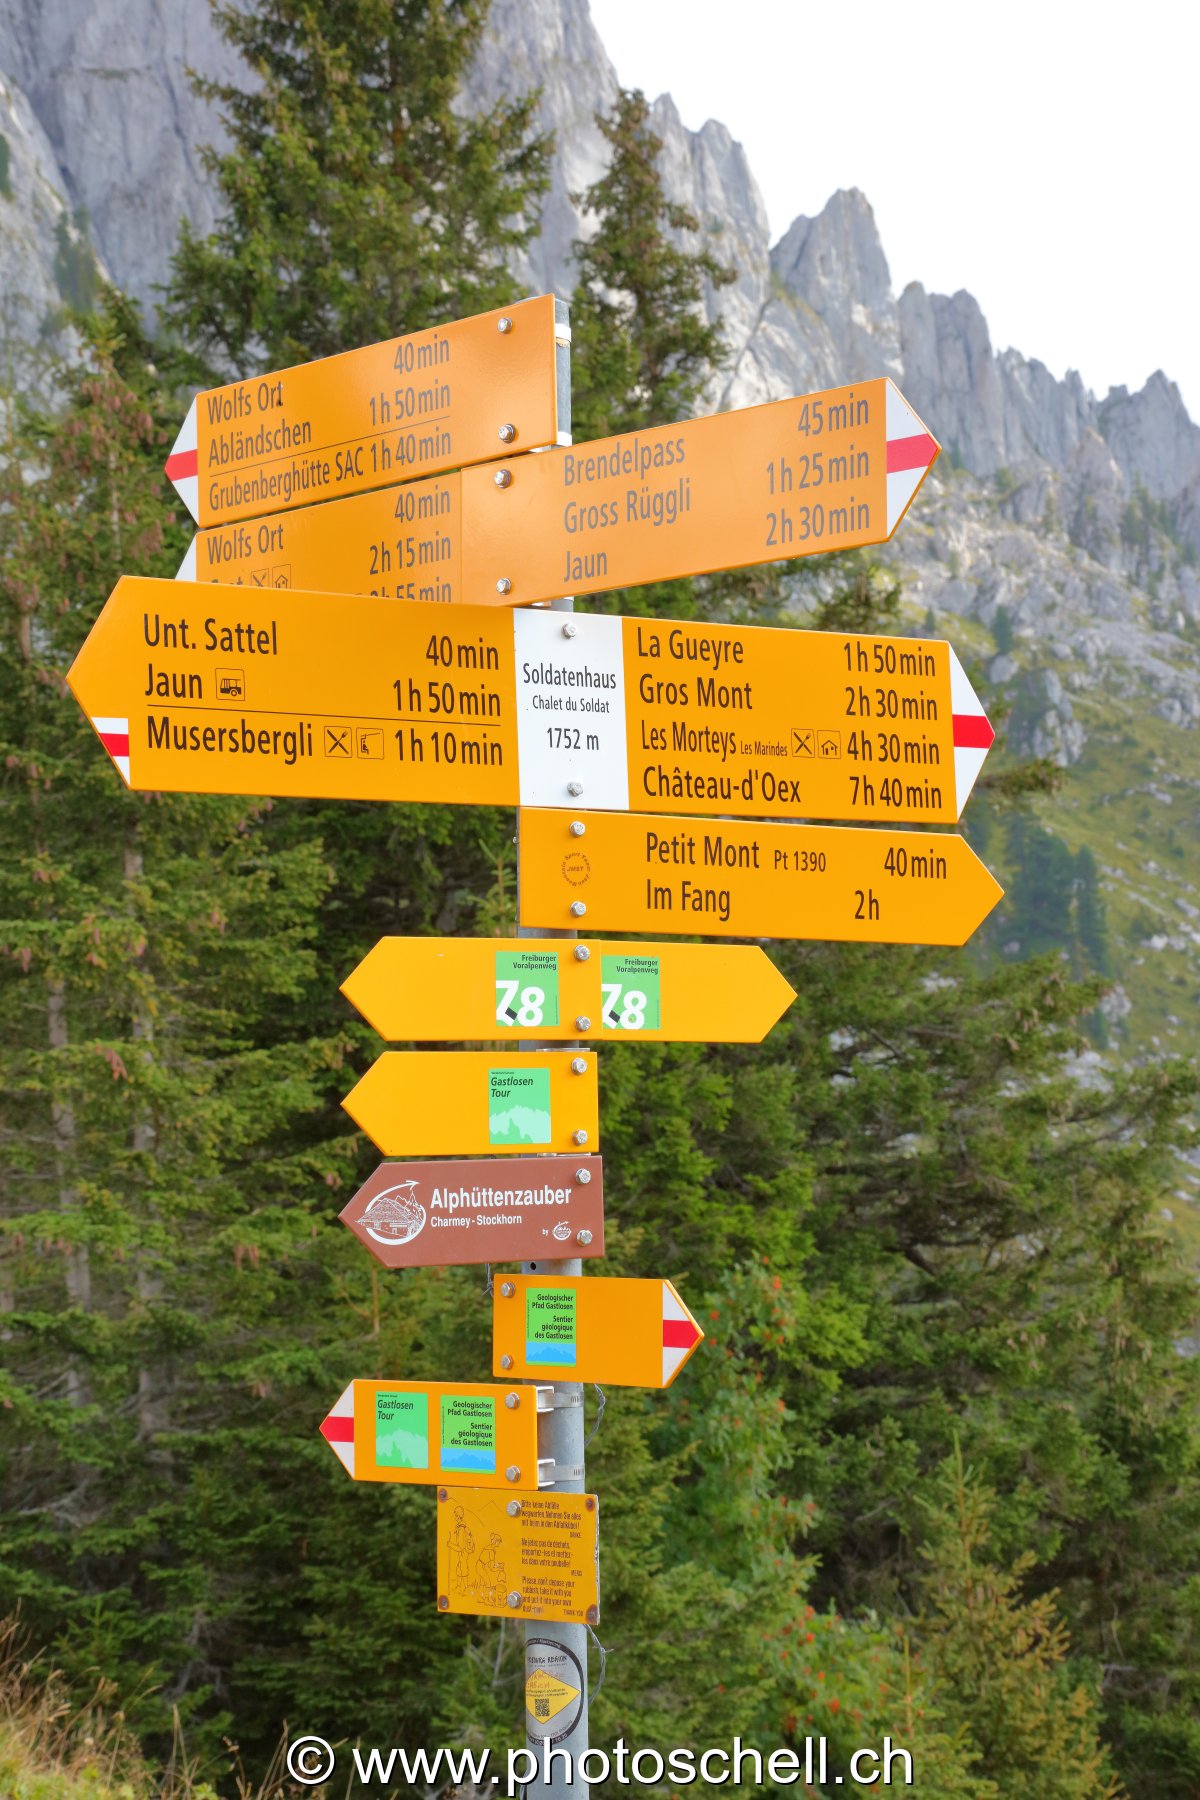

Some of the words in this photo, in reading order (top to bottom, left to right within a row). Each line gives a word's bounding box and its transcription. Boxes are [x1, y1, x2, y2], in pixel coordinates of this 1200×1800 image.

[207, 386, 251, 425] Wolfs
[258, 381, 283, 411] Ort
[393, 333, 450, 374] 40min
[208, 419, 312, 468] Abländschen
[369, 393, 390, 426] 1h
[395, 379, 450, 420] 50min
[564, 438, 685, 486] Brendelpass
[798, 392, 869, 436] 45min
[210, 460, 330, 510] Grubenberghütte
[335, 446, 363, 481] SAC
[370, 439, 391, 472] 1h
[395, 427, 450, 466] 40min
[564, 501, 618, 533] Gross
[627, 478, 690, 526] Rüggli
[767, 457, 792, 495] 1h
[799, 444, 869, 489] 25min
[207, 530, 252, 565] Wolfs
[258, 524, 284, 553] Ort
[393, 485, 450, 524] 40min
[564, 551, 607, 582] Jaun
[766, 508, 793, 546] 2h
[800, 496, 869, 540] 30min
[144, 614, 196, 649] Unt.
[205, 618, 277, 655] Sattel
[426, 635, 498, 670] 40min
[638, 627, 660, 658] La
[669, 629, 743, 671] Gueyre
[844, 641, 868, 672] 1h
[874, 644, 935, 677] 50min
[523, 662, 616, 689] Soldatenhaus
[145, 663, 202, 699] Jaun
[393, 678, 421, 712] 1h
[428, 682, 500, 716] 50min
[640, 673, 688, 705] Gros
[697, 677, 752, 710] Mont
[845, 686, 870, 716] 2h
[876, 689, 937, 720] 30min
[532, 695, 563, 710] Chalet
[565, 696, 577, 711] du
[580, 698, 610, 713] Soldat
[148, 716, 312, 765] Musersbergli
[395, 728, 423, 762] 1h
[431, 732, 502, 766] 10min
[547, 728, 581, 749] 1752
[587, 735, 599, 750] m
[642, 720, 667, 750] Les
[672, 722, 736, 759] Morteys
[741, 741, 752, 755] Les
[754, 741, 787, 756] Marindes
[847, 730, 872, 761] 4h
[878, 733, 939, 765] 30min
[643, 765, 801, 802] Château-d'Oex
[849, 775, 874, 806] 7h
[880, 778, 942, 809] 40min
[647, 832, 695, 865] Petit
[704, 836, 759, 868] Mont
[774, 850, 788, 870] Pt
[794, 851, 826, 872] 1390
[884, 847, 946, 879] 40min
[647, 879, 672, 910] Im
[682, 881, 730, 922] Fang
[855, 889, 879, 920] 2h
[513, 962, 557, 971] Voralpenweg
[522, 954, 556, 963] Freiburger
[624, 958, 658, 972] Freiburger
[616, 966, 658, 975] Voralpenweg
[491, 1076, 533, 1086] Gastlosen
[491, 1088, 511, 1098] Tour
[430, 1185, 571, 1213] Alphüttenzauber
[431, 1216, 471, 1228] Charmey
[477, 1214, 522, 1225] Stockhorn
[537, 1294, 573, 1303] Geologischer
[546, 1302, 573, 1310] Gastlosen
[553, 1315, 573, 1325] Sentier
[534, 1331, 544, 1339] des
[377, 1399, 414, 1410] Gastlosen
[378, 1411, 394, 1420] Tour
[447, 1408, 461, 1416] Pfad
[462, 1409, 492, 1417] Gastlosen
[453, 1401, 492, 1410] Geologischer
[471, 1422, 492, 1430] Sentier
[463, 1438, 493, 1447] Gastlosen
